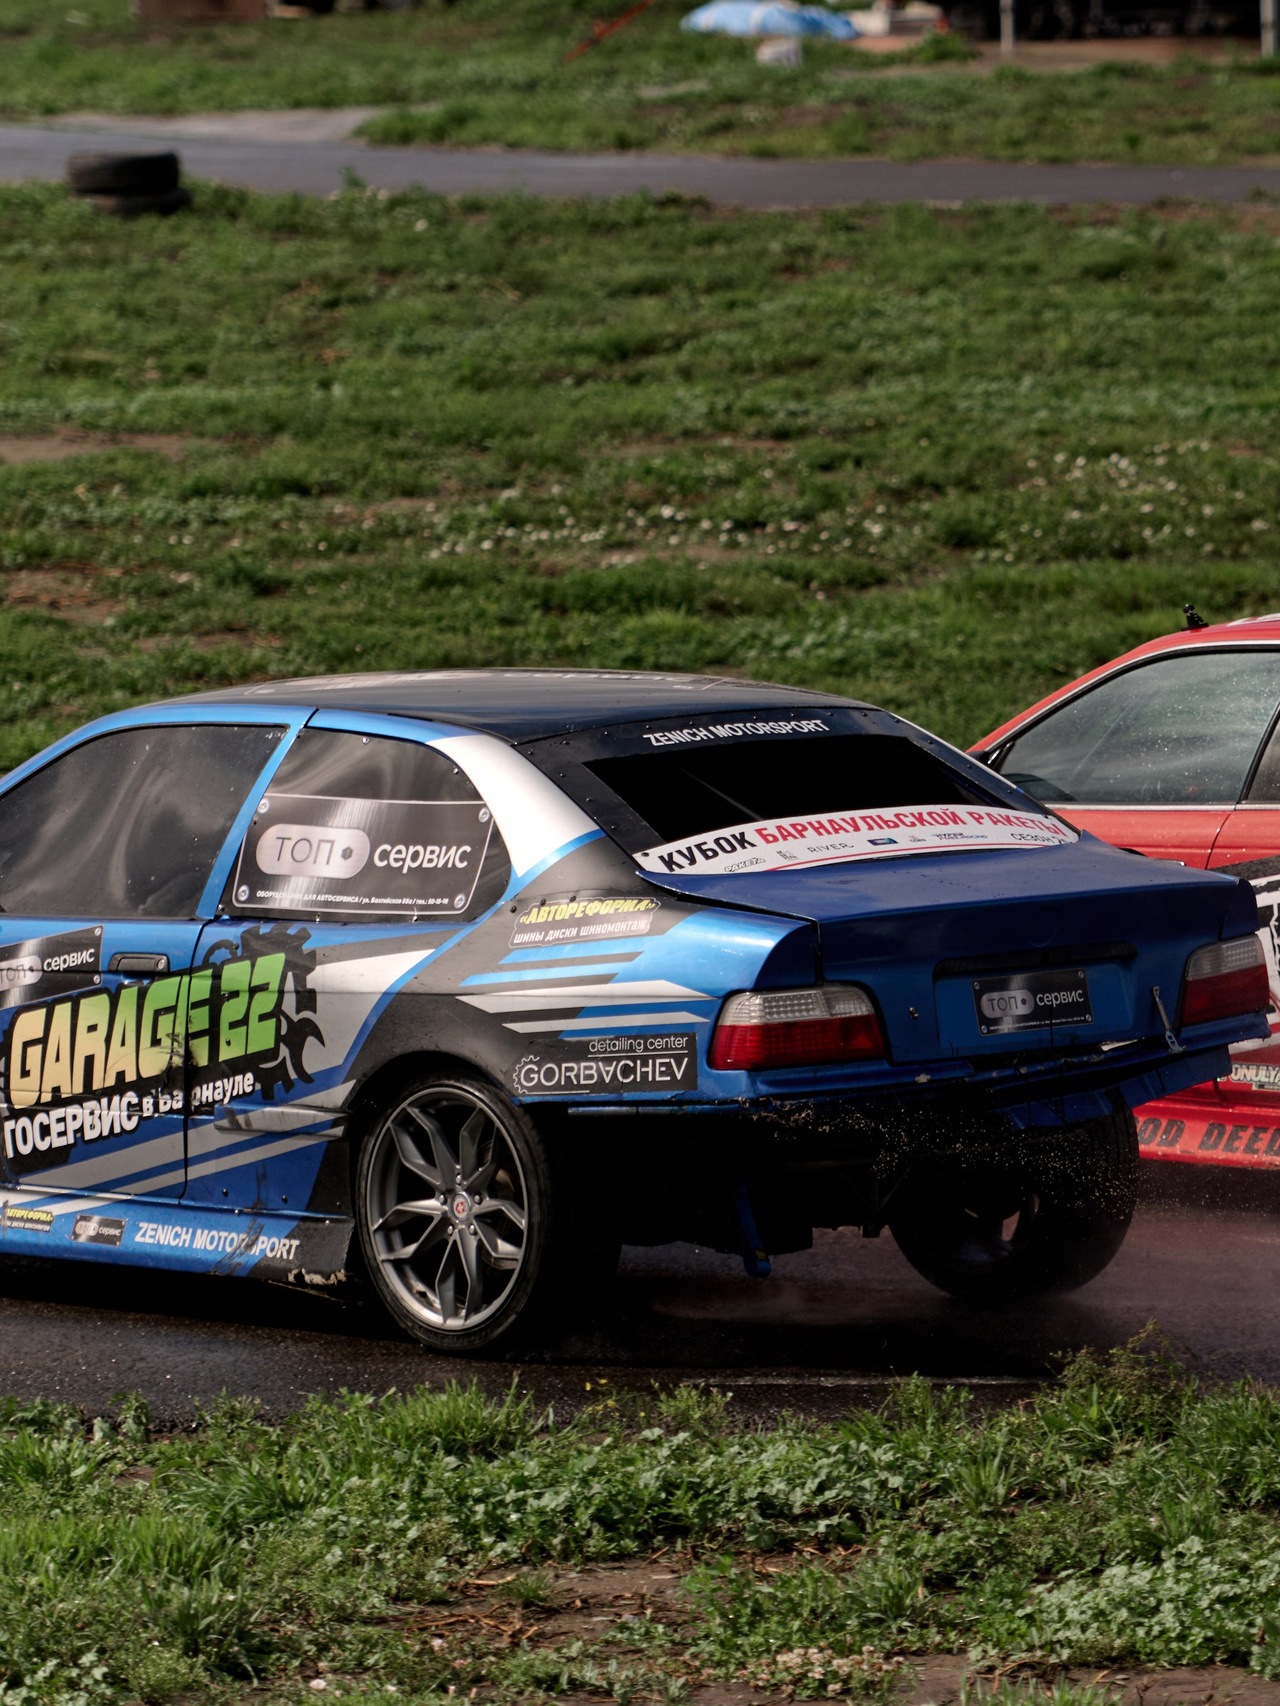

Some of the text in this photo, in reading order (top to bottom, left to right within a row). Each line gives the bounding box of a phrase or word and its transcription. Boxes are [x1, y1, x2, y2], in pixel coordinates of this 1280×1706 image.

[643, 719, 830, 747] ZENICH MOTORSPORT
[657, 807, 1069, 873] КУБОК БАРНАУЛЬСКОЙ РАКЕТЫ
[1010, 833, 1055, 844] СЕЗОН
[276, 836, 472, 874] ТОП сервис
[43, 948, 96, 972] сервис
[987, 990, 1085, 1012] ТОП сервис
[9, 953, 286, 1110] GARAGE 22
[588, 1036, 688, 1053] detailing center
[134, 1222, 193, 1249] ZENICH
